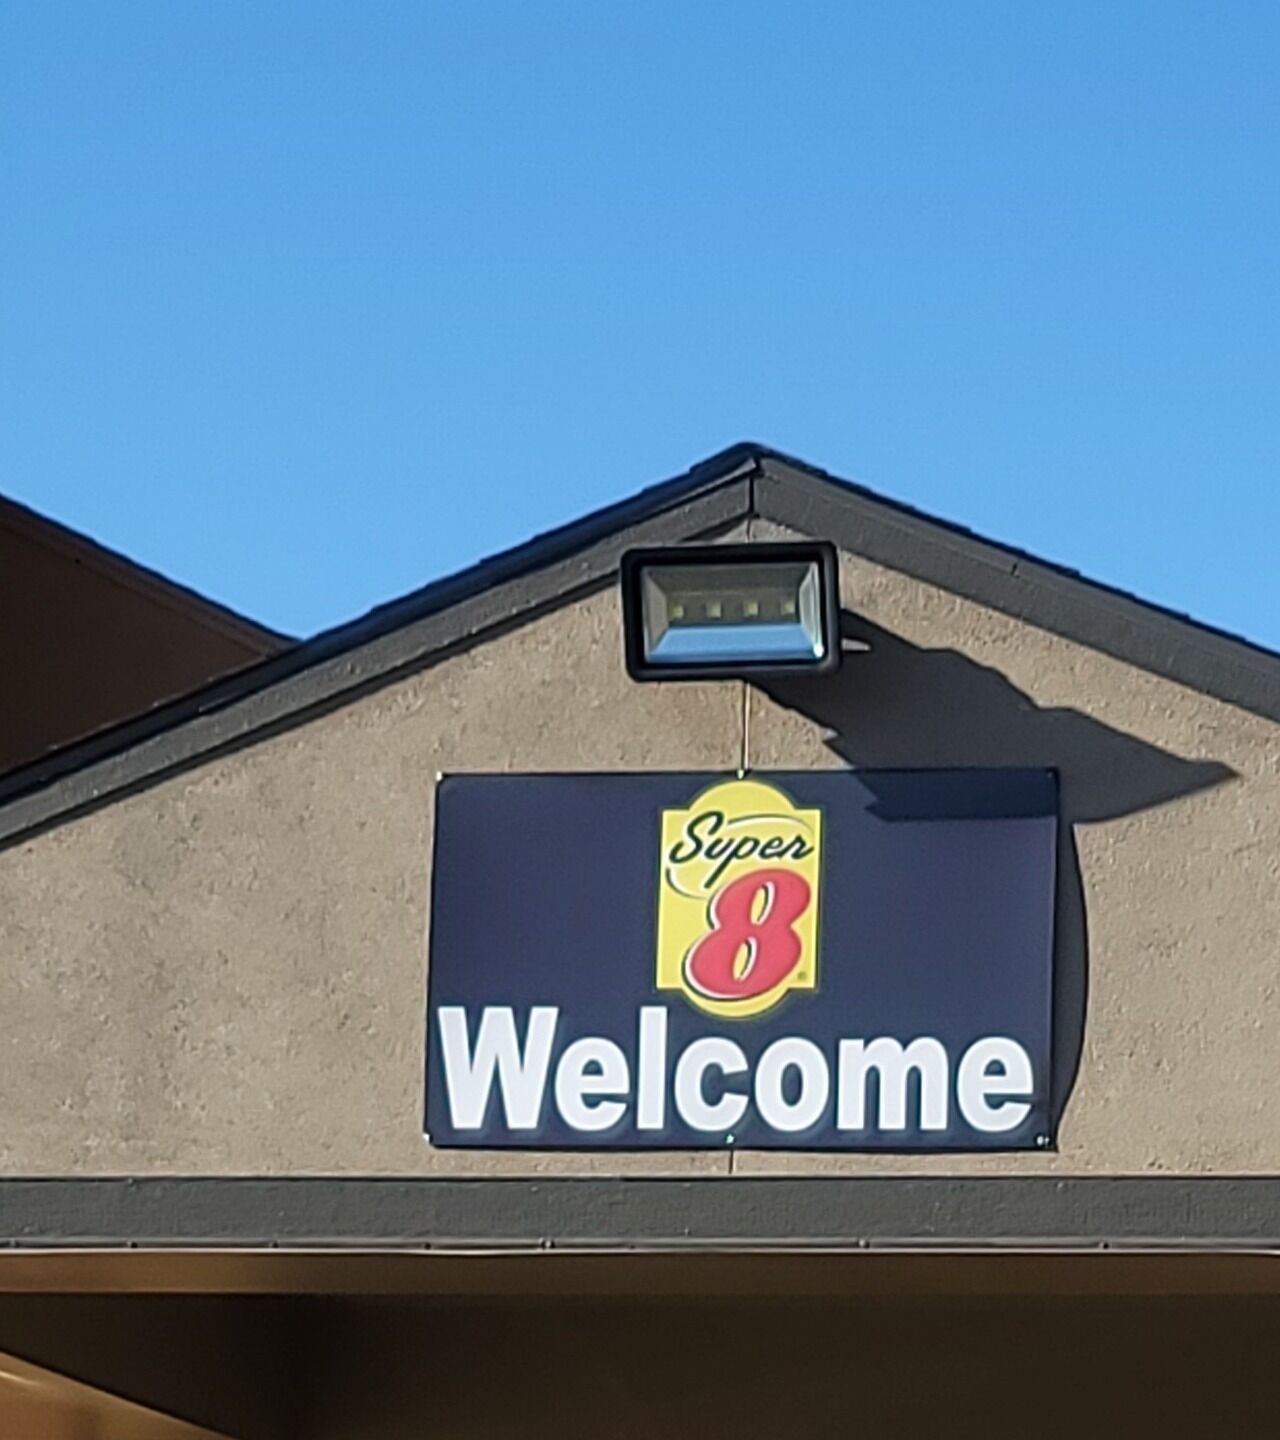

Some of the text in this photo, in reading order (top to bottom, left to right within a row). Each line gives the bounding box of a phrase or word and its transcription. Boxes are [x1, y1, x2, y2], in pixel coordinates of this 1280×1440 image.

[668, 810, 815, 889] Super
[682, 867, 812, 1003] 8
[437, 1006, 1034, 1132] Welcome
